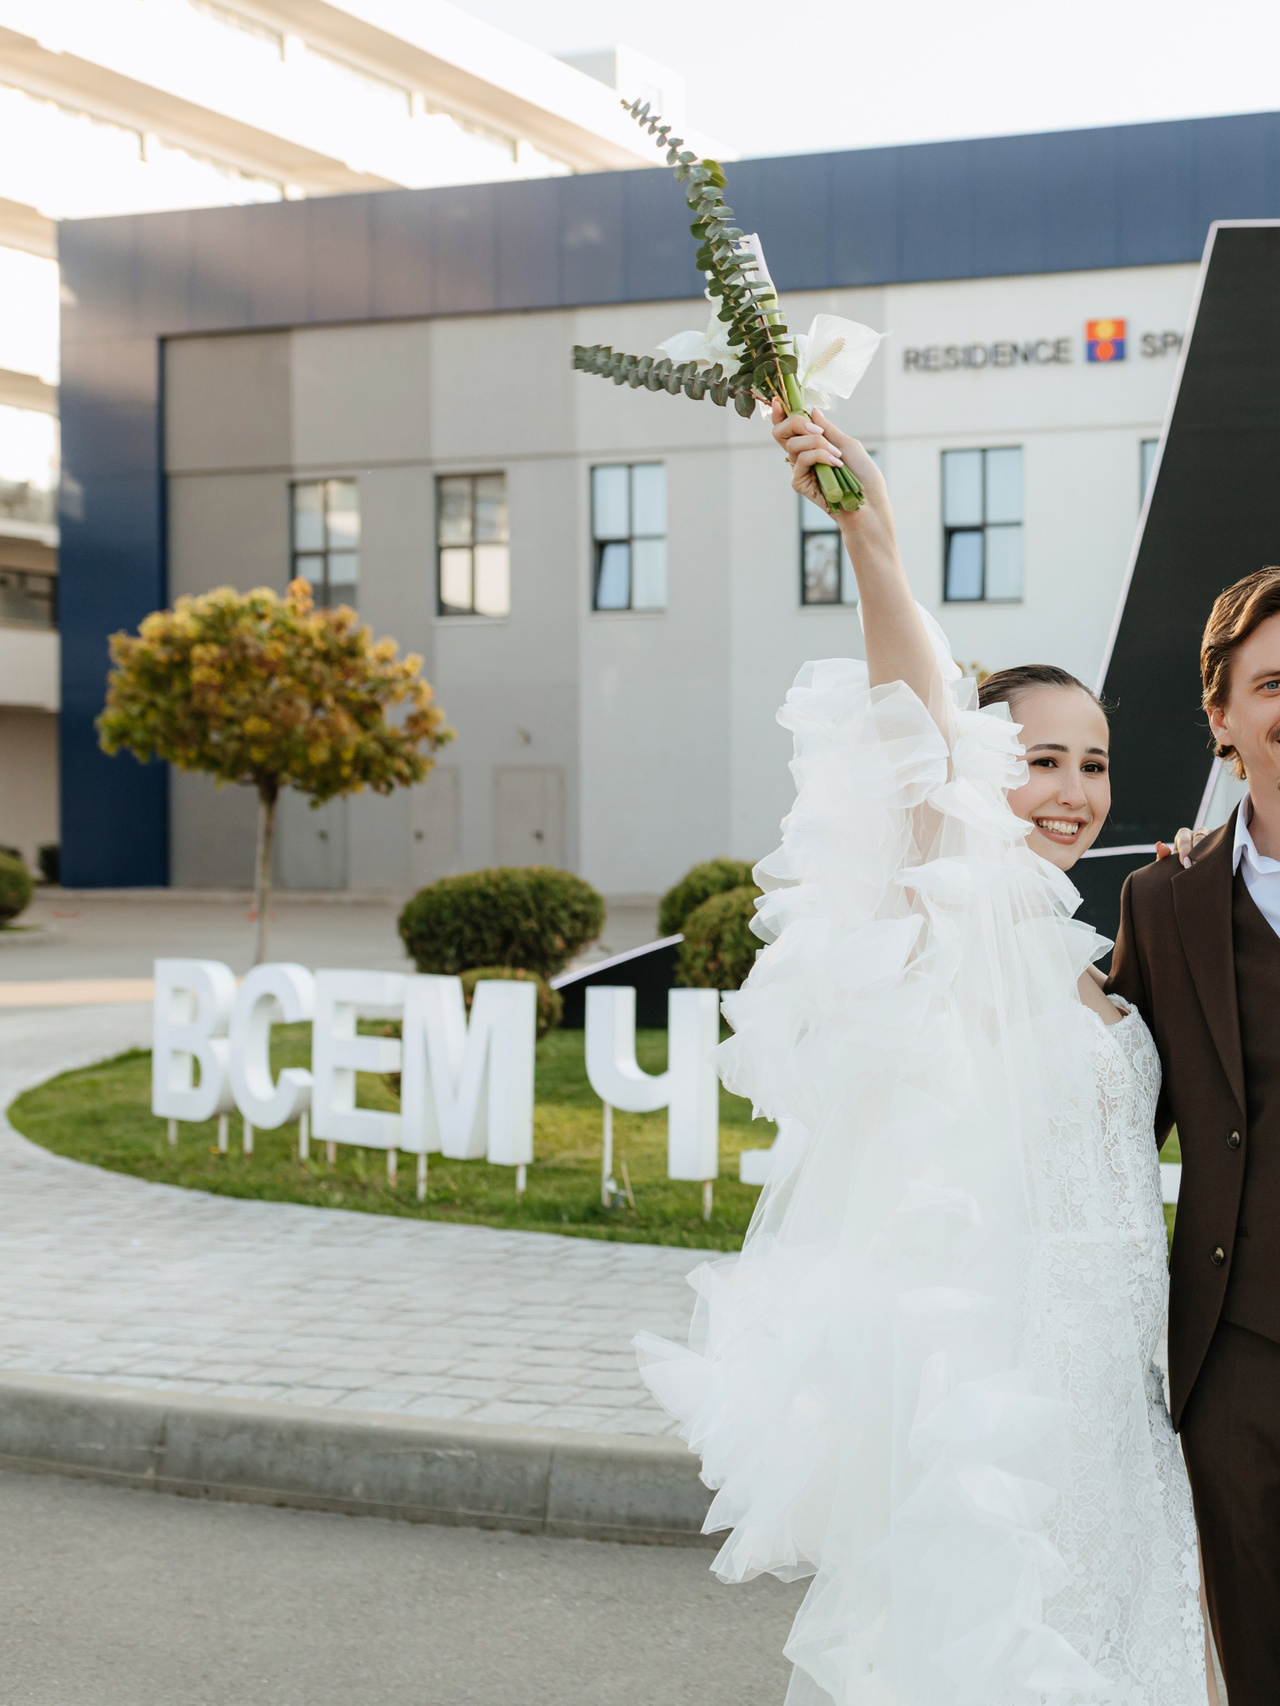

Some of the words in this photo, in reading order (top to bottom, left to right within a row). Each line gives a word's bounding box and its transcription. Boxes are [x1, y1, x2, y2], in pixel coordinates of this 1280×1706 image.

[903, 338, 1072, 372] RESIDENCE
[1141, 331, 1183, 358] SP
[152, 958, 536, 1165] ВСЕМ
